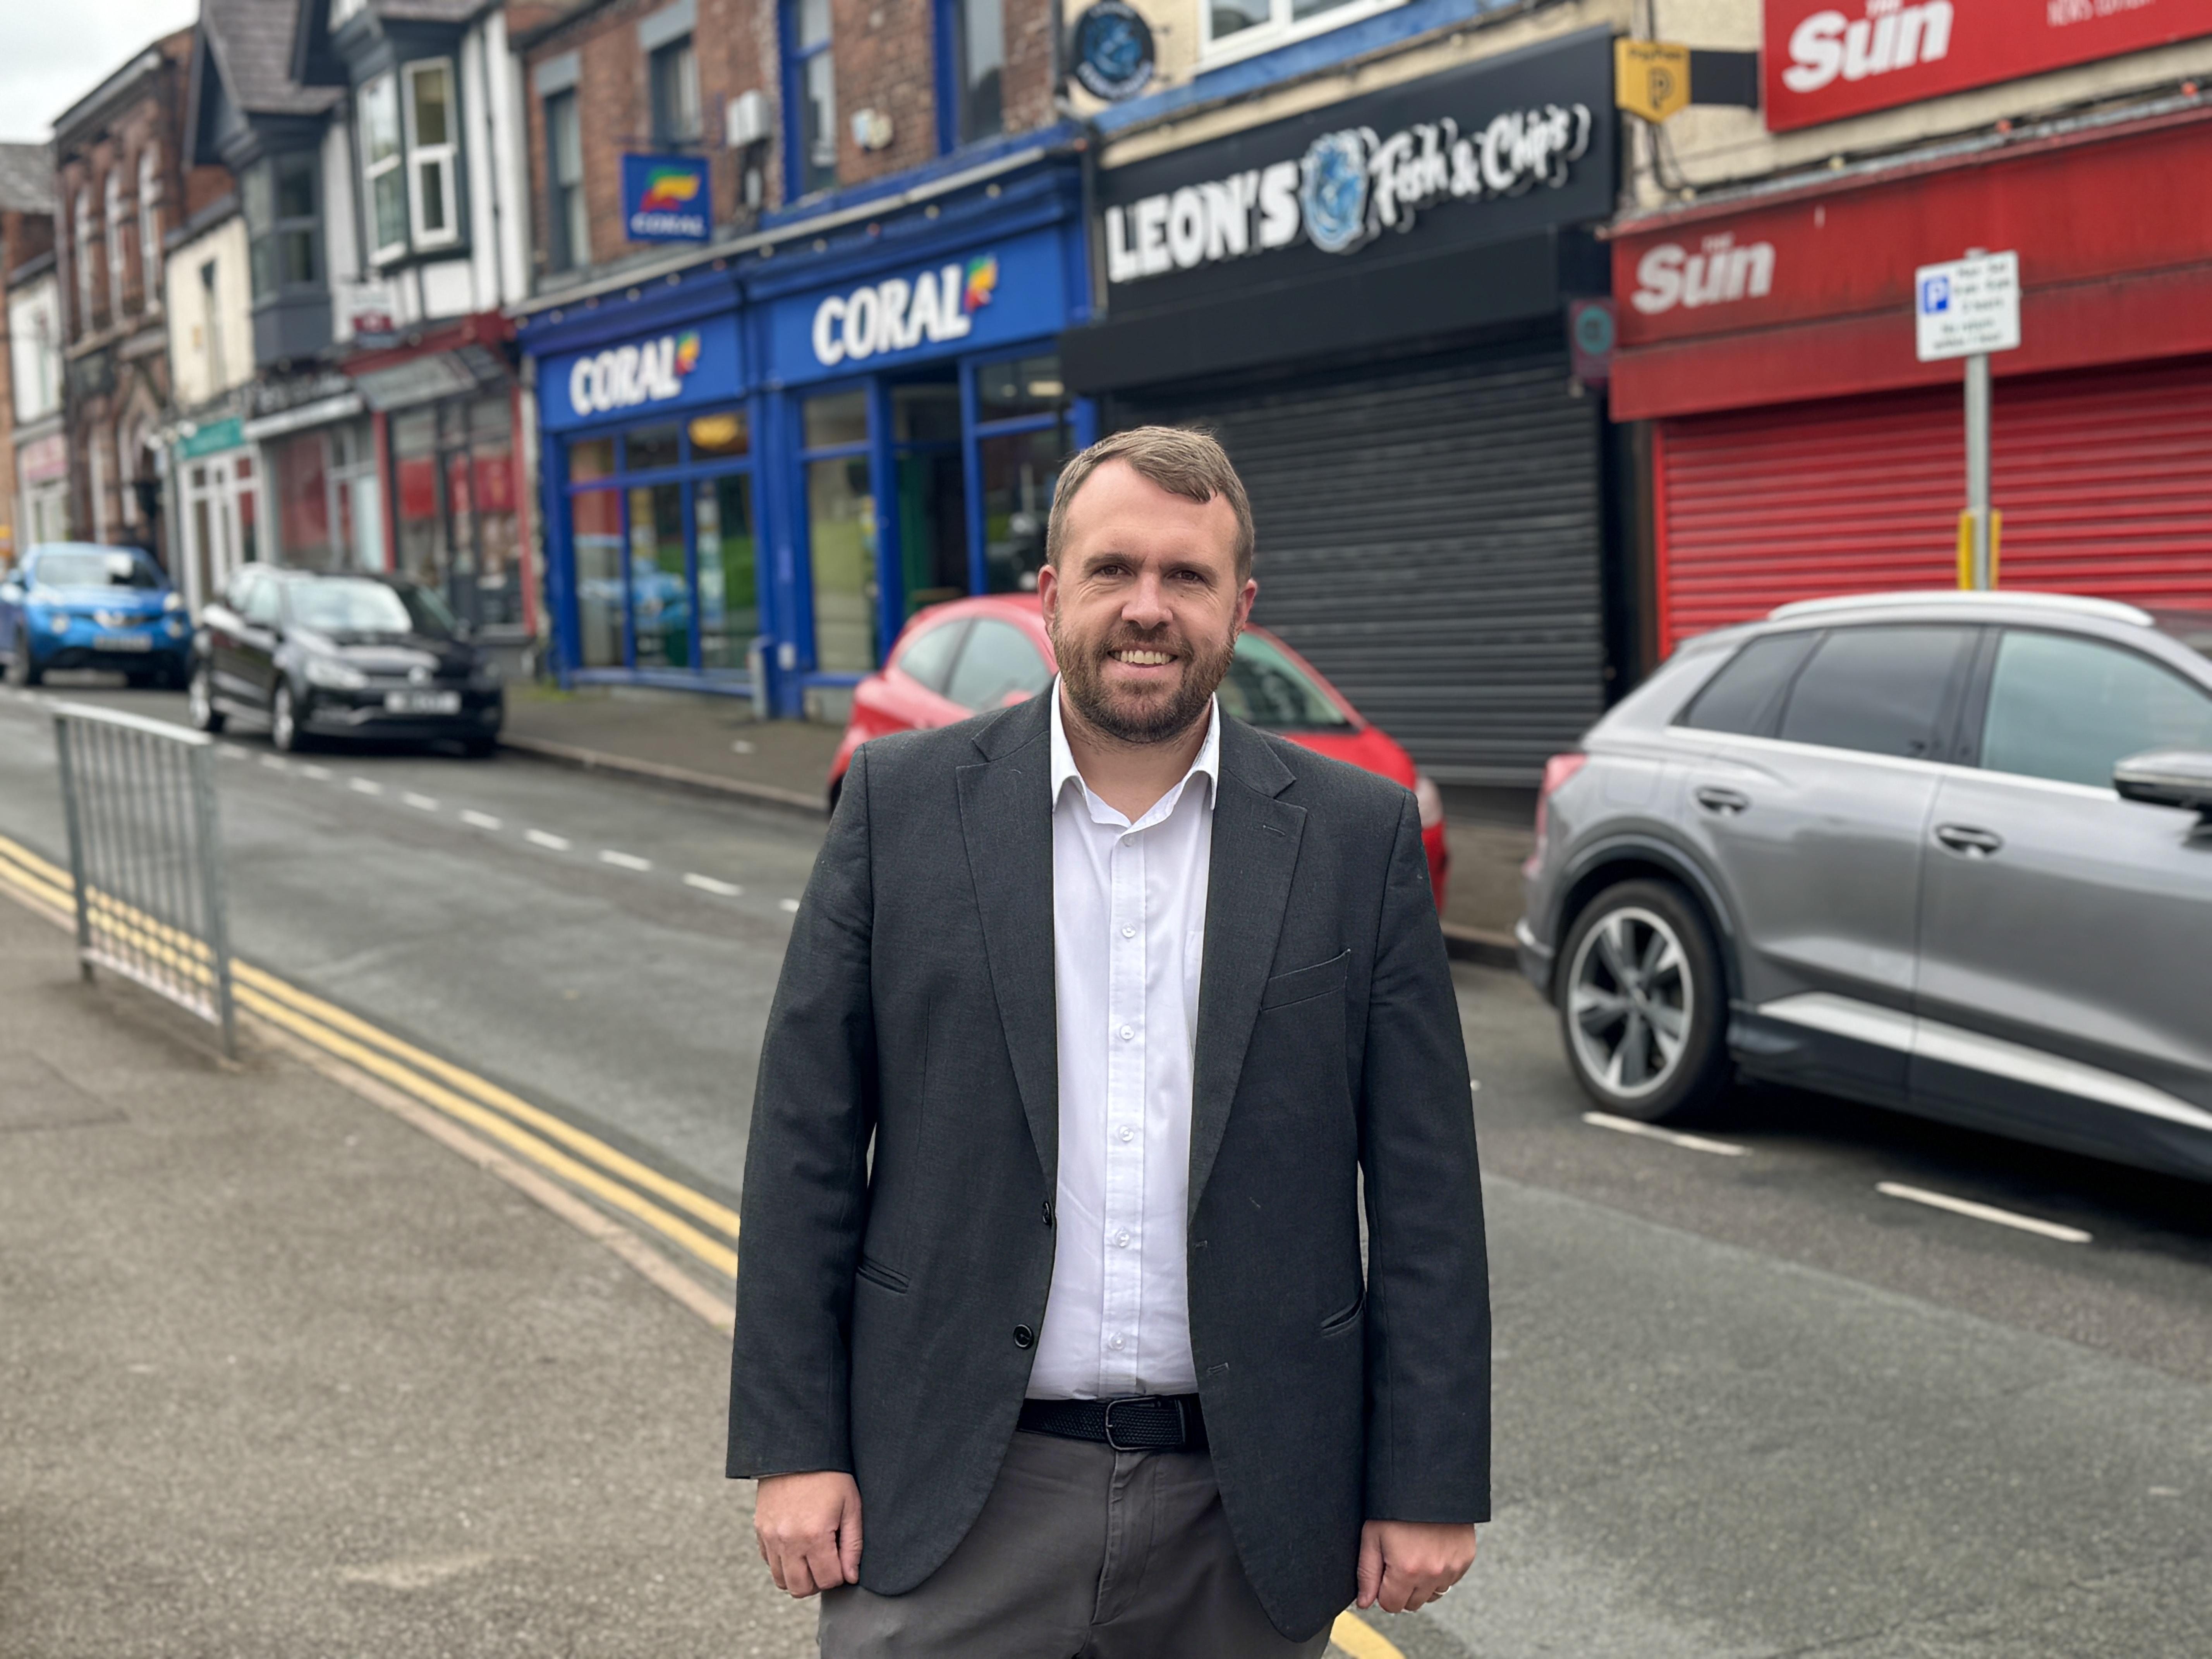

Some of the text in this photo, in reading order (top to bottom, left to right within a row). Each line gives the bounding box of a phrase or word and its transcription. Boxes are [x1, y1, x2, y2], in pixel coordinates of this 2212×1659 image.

[1782, 0, 1954, 92] Sun
[1106, 161, 1300, 283] LEON'S
[812, 263, 970, 366] CORAL
[1631, 240, 1775, 314] Sun
[570, 336, 682, 416] CORAL
